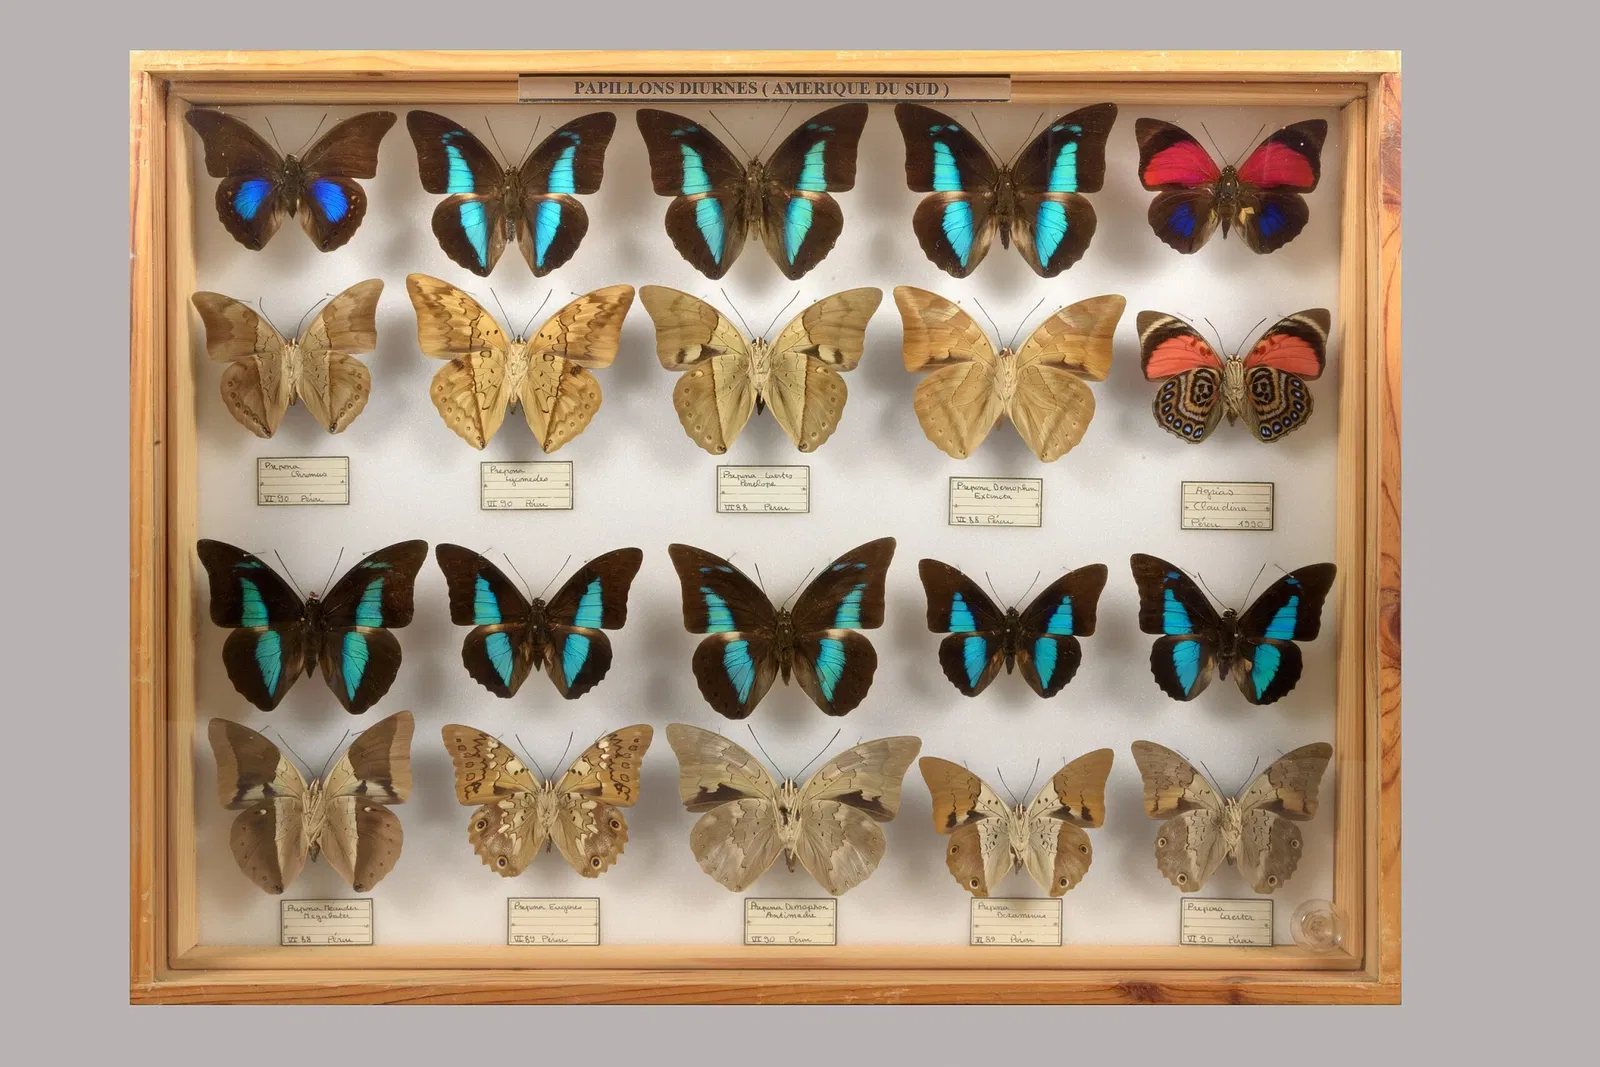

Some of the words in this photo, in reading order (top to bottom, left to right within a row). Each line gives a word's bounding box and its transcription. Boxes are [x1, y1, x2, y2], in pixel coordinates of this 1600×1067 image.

[574, 80, 675, 96] PAPILLONS
[679, 80, 759, 96] DIURNES
[874, 81, 900, 96] DU
[1195, 486, 1234, 500] Agrias
[1193, 501, 1247, 512] Claudina
[1200, 935, 1214, 943] 90
